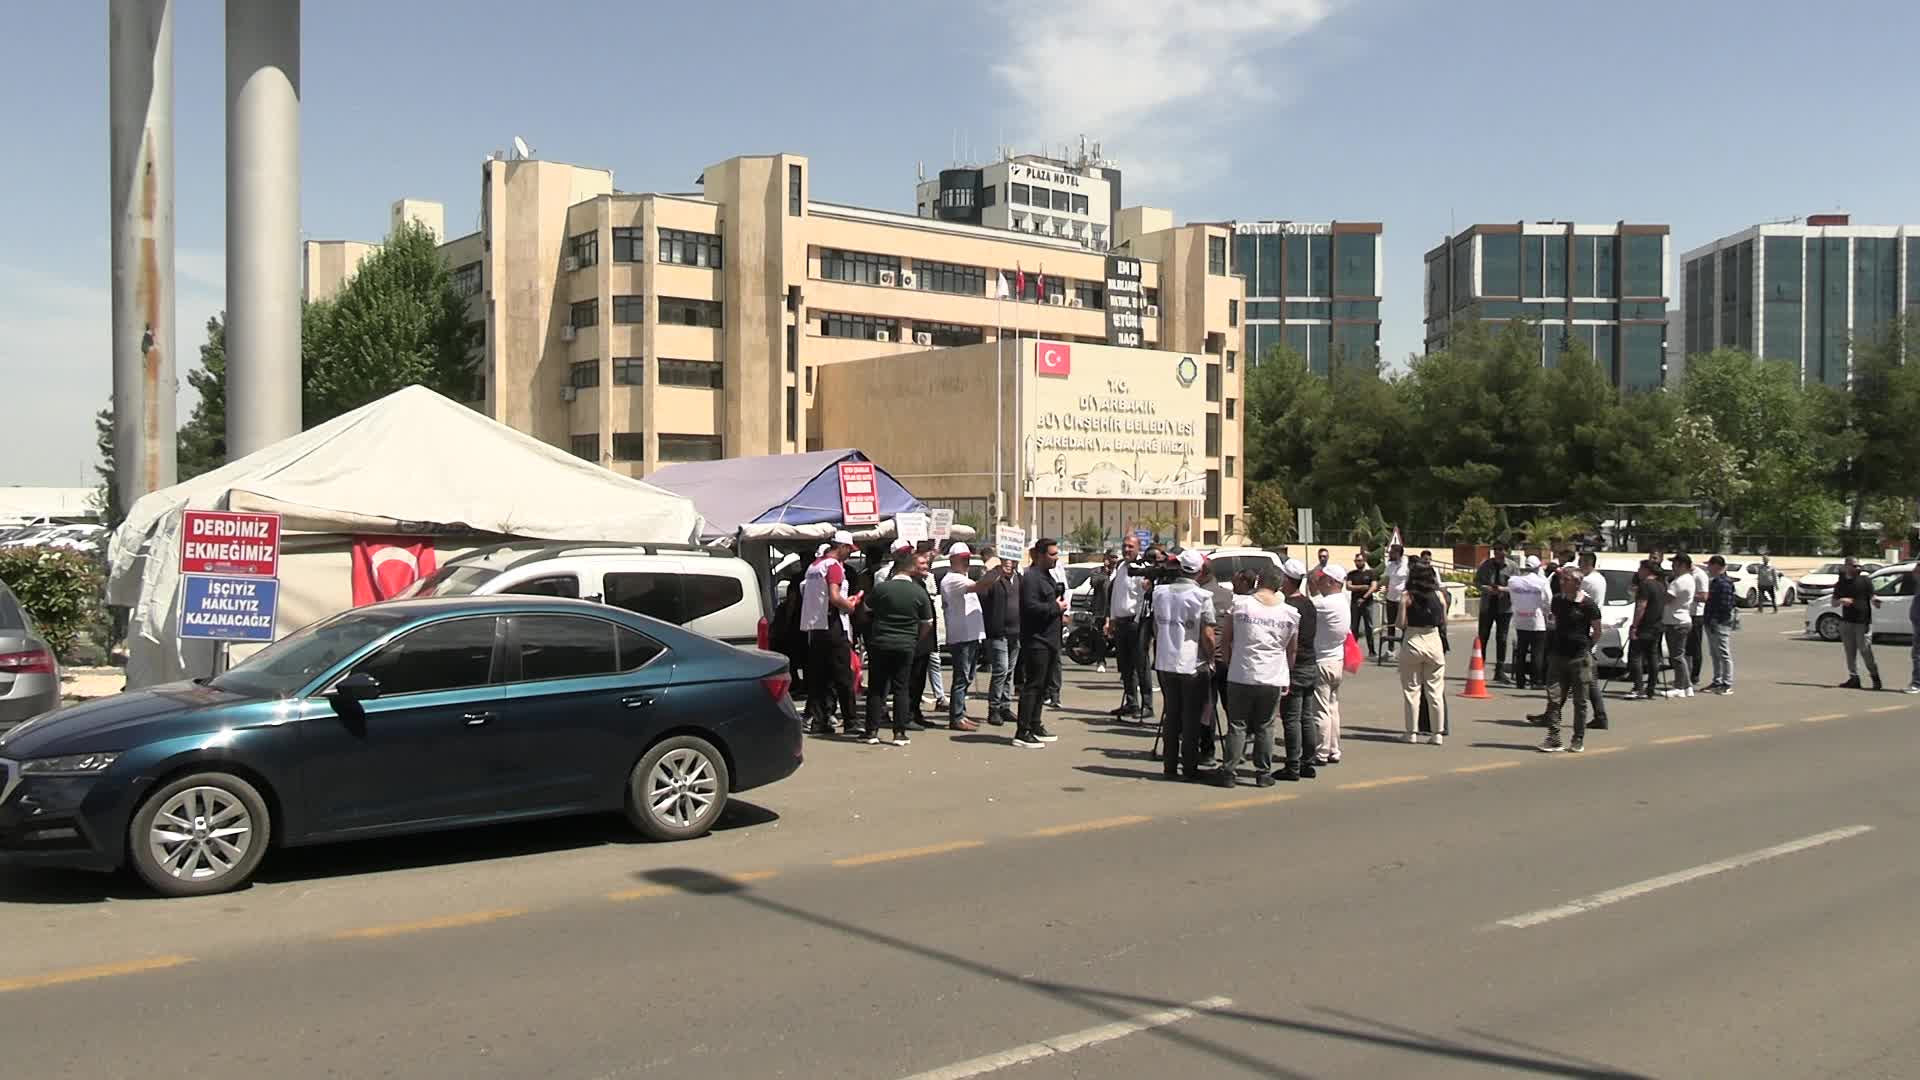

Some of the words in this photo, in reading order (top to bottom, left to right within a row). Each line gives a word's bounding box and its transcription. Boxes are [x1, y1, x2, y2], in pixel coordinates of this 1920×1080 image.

[1026, 168, 1051, 182] PLAZA
[1054, 173, 1079, 187] HOTEL
[1106, 378, 1129, 394] T.C.
[1078, 395, 1157, 415] DİYARBAKIR
[1036, 412, 1122, 433] BÜYÜKŞEHİR
[1124, 418, 1198, 436] BELEDİYESİ
[193, 517, 269, 538] DERDİMİZ
[185, 541, 273, 561] EKMEĞİMİZ
[208, 580, 256, 598] İŞÇİYİZ
[201, 597, 259, 611] HAKLIYIZ
[185, 612, 271, 627] KAZANACAĞIZ
